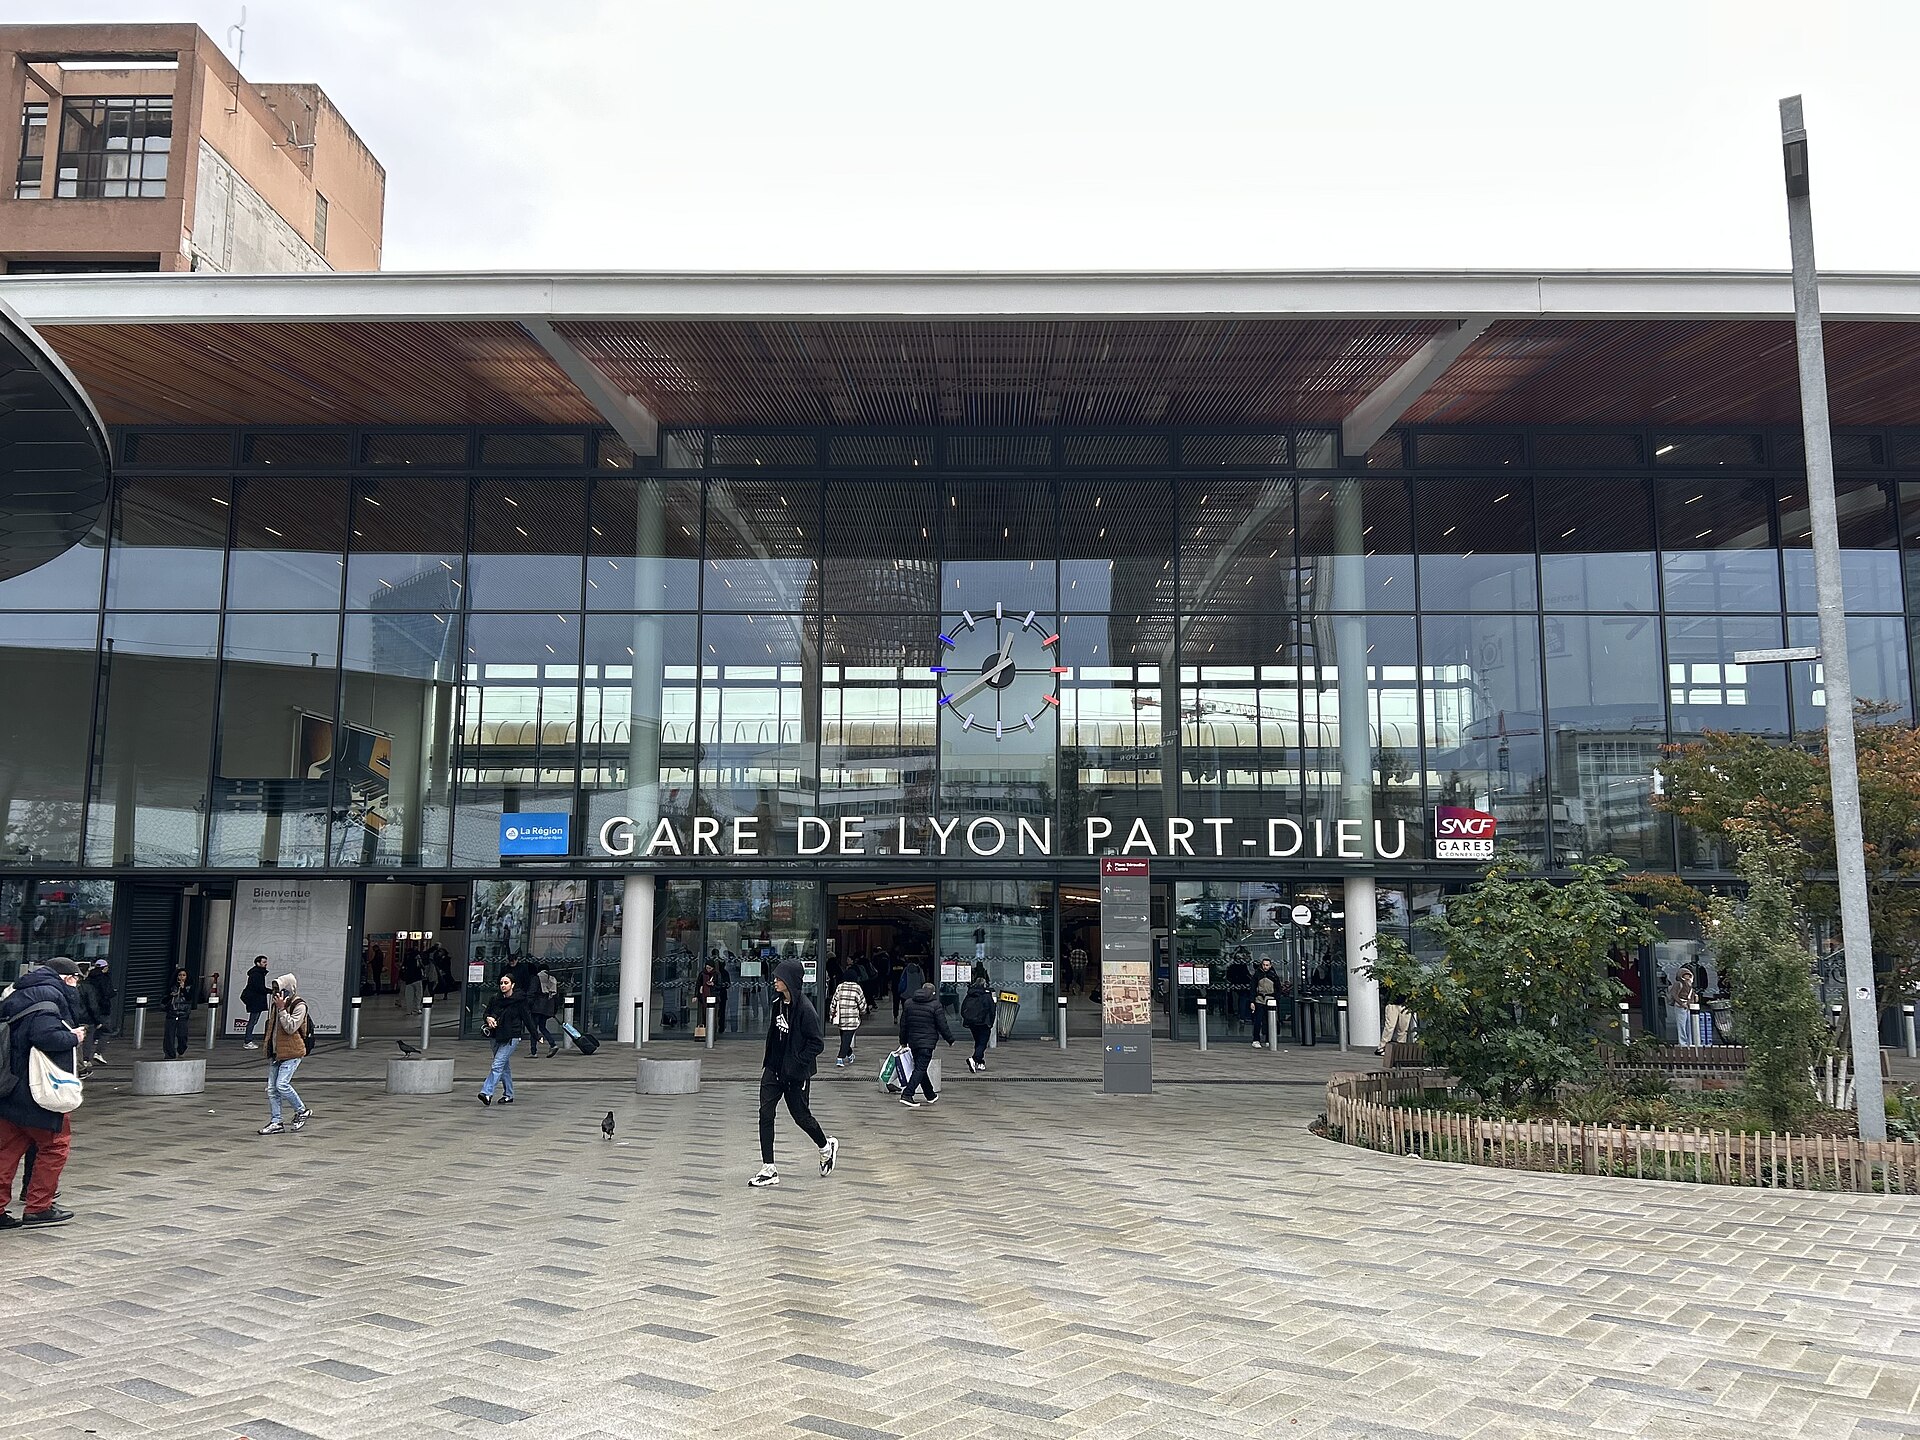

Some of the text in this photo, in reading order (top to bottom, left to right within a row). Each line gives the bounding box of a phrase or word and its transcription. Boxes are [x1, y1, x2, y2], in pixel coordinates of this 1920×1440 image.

[520, 827, 563, 836] La Région
[1438, 818, 1494, 835] SNCF
[599, 815, 1405, 858] GARE DE LYON PART-DIEU
[1438, 841, 1491, 851] GARES
[253, 887, 311, 898] Bienvenue
